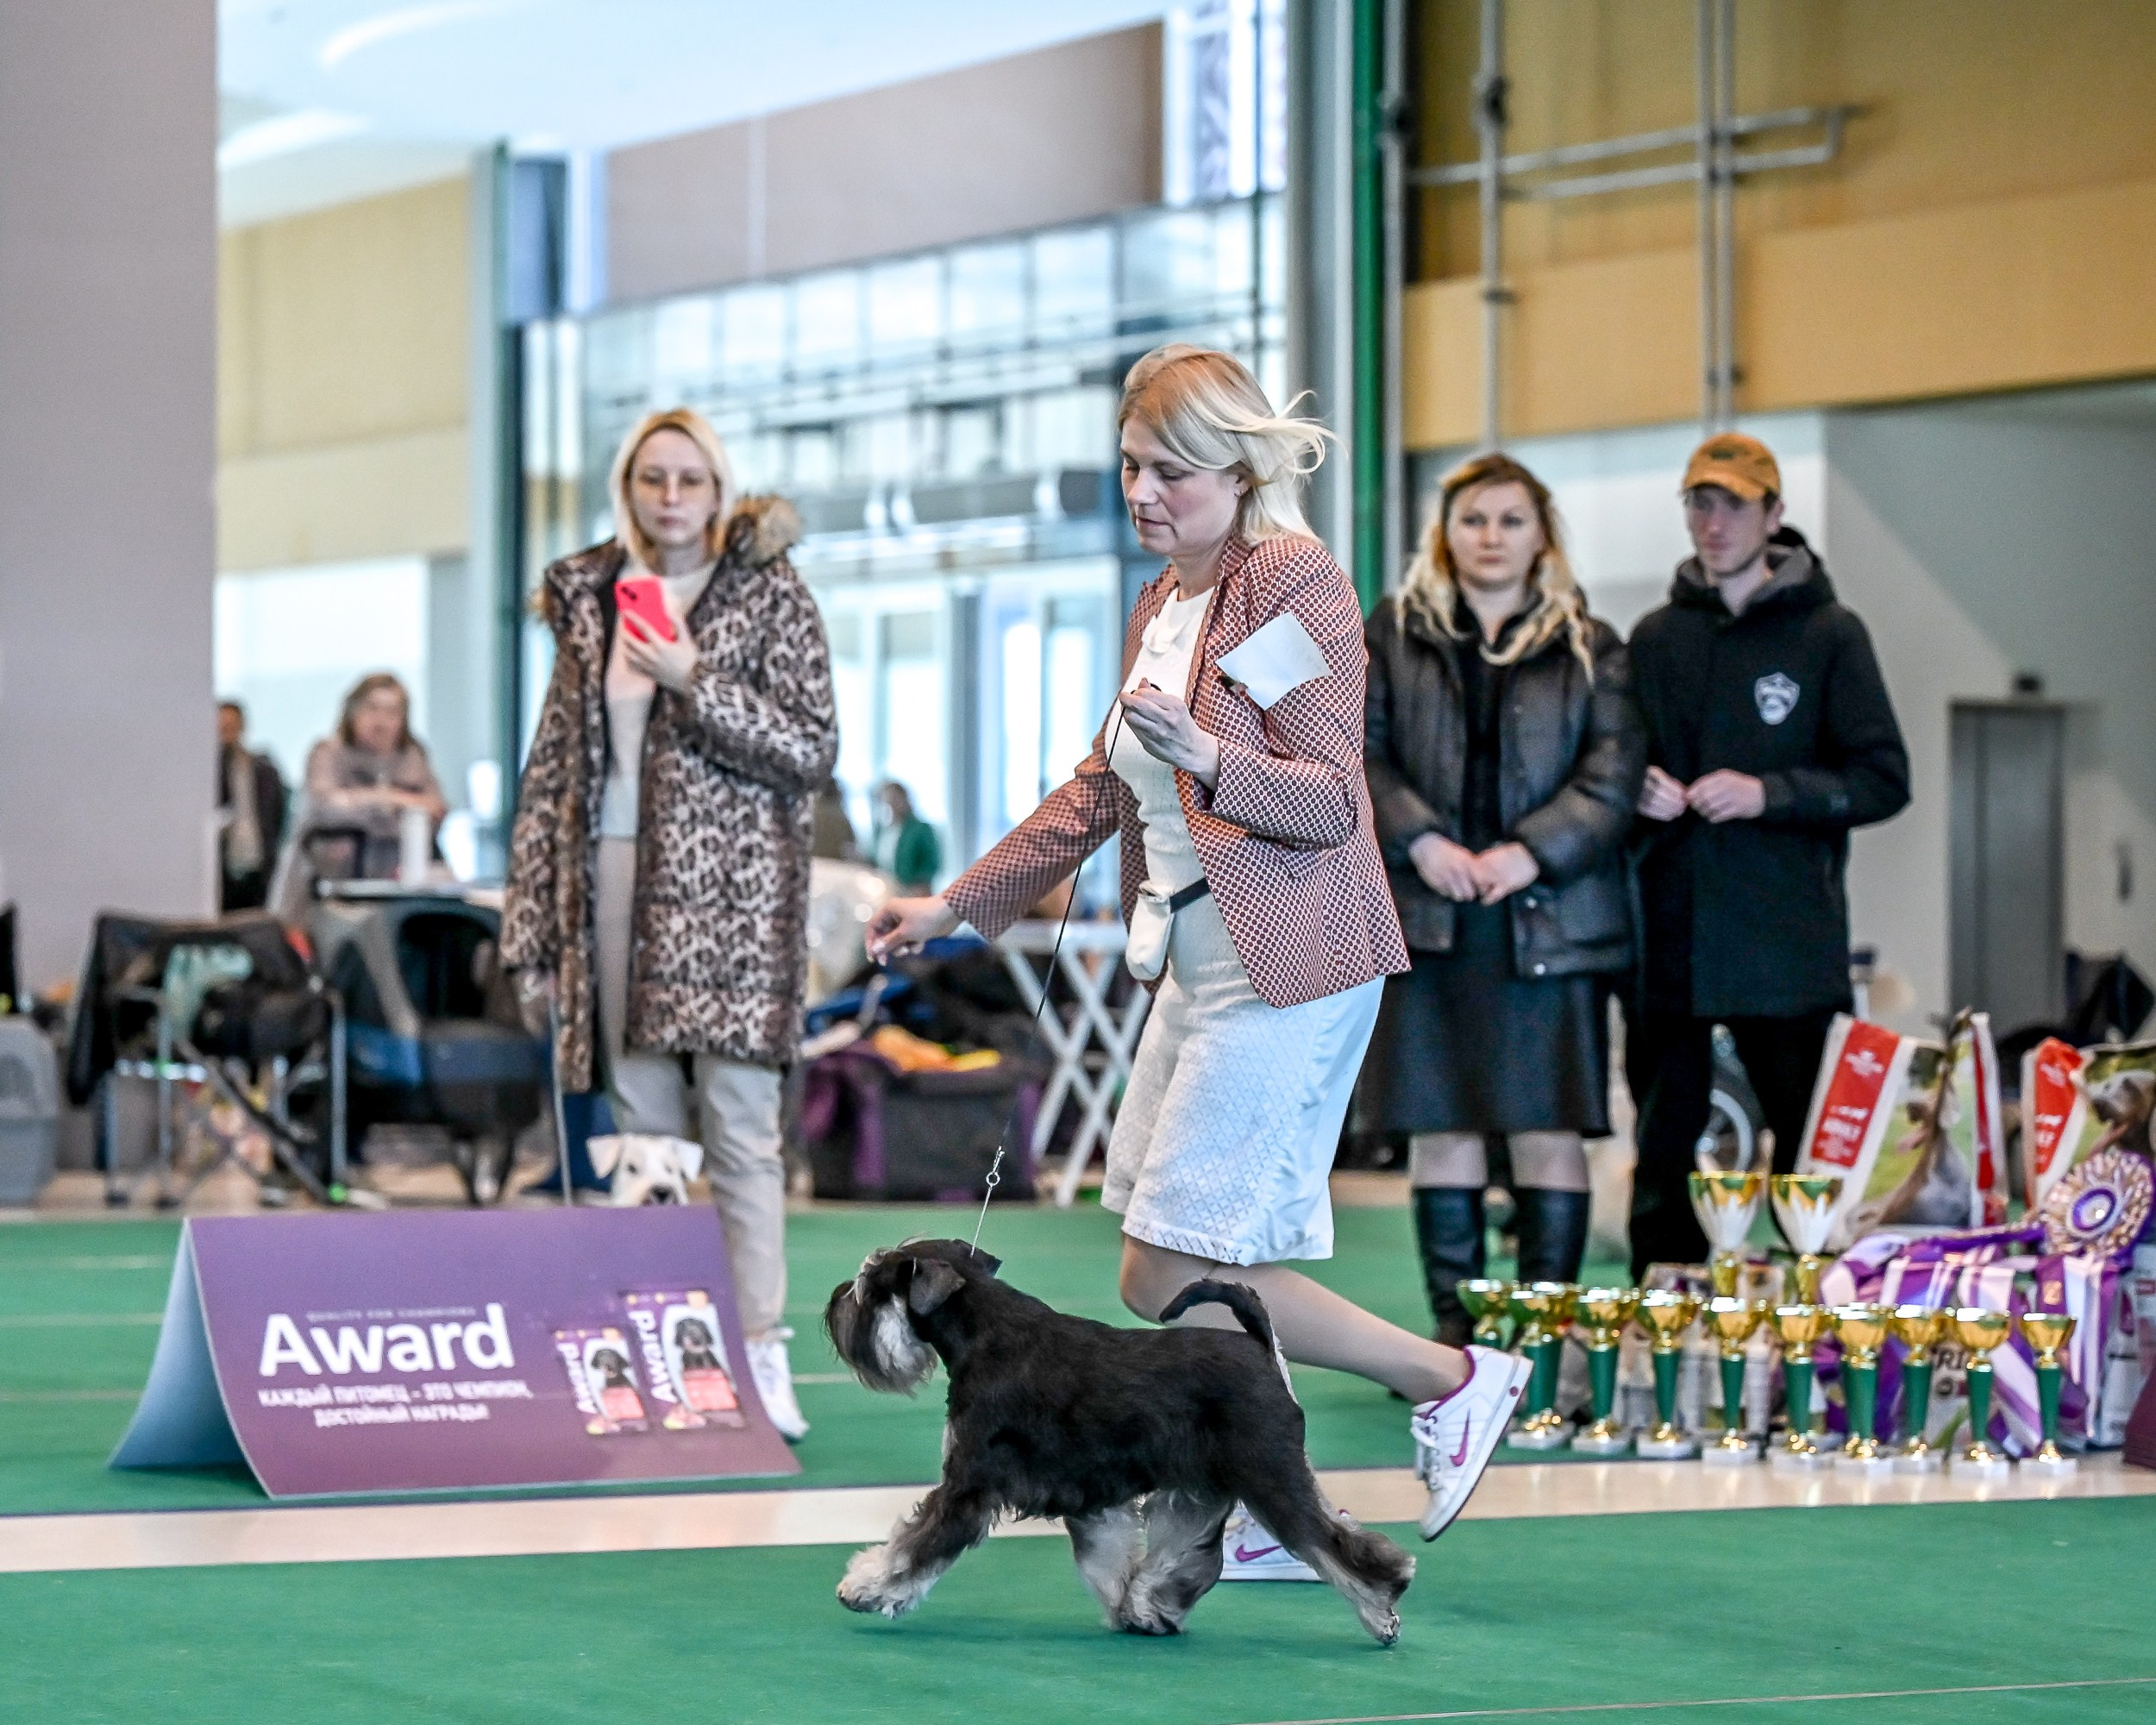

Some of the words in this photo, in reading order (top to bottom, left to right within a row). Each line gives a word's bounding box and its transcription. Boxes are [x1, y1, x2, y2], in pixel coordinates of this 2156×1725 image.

[260, 1302, 516, 1377] Award
[626, 1309, 678, 1403] Award
[258, 1383, 334, 1408] КАЖДЫЙ
